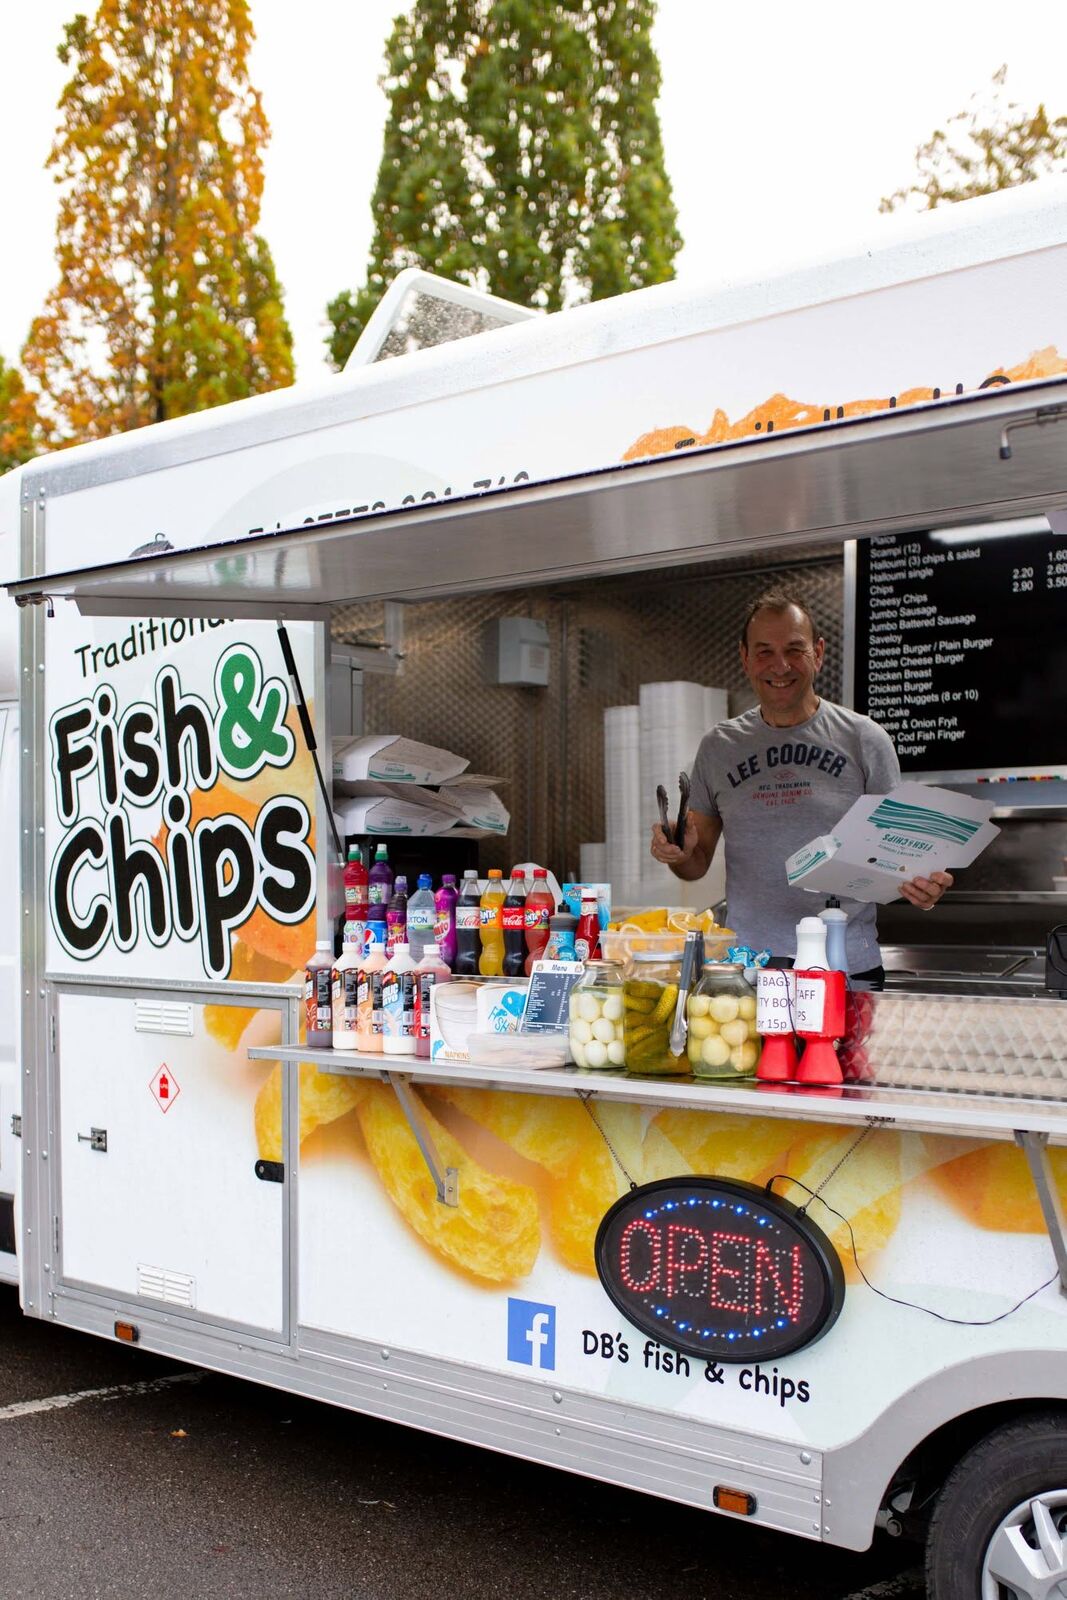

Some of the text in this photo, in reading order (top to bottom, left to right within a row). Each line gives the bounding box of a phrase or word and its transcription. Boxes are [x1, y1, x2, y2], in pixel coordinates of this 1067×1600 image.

[903, 543, 921, 556] (12)
[870, 547, 980, 571] Halloumi (3) chips & salad
[870, 567, 934, 583] Halloumi single
[869, 585, 894, 595] Chips
[869, 593, 928, 608] Cheesy Chips
[869, 606, 937, 621] Jumbo Sausage
[869, 614, 976, 633] Jumbo Battered Sausage
[869, 634, 902, 645] Saveloy
[74, 618, 234, 677] Tradition
[868, 647, 901, 657] Cheese
[903, 643, 932, 655] Burger
[938, 640, 961, 651] Plain
[963, 638, 993, 650] Burger
[868, 653, 965, 670] Double Cheese Burger
[868, 668, 932, 682] Chicken Breast
[868, 681, 933, 695] Chicken Burger
[868, 695, 902, 707] Chicken
[904, 693, 939, 706] Nuggets
[952, 692, 962, 700] or
[964, 689, 979, 701] 10)
[868, 707, 910, 719] Fish Cake
[902, 719, 908, 729] &
[910, 717, 936, 728] Onion
[53, 648, 292, 821] Fish &
[897, 731, 915, 742] Cod
[917, 730, 935, 741] Fish
[937, 730, 965, 741] Finger
[897, 744, 927, 756] Burger
[727, 743, 847, 788] LEE COOPER
[882, 833, 908, 845] CHIPS
[912, 840, 933, 851] FISH
[53, 791, 314, 976] Chips
[763, 976, 791, 987] BAGS
[772, 997, 795, 1008] BOX
[768, 1018, 787, 1030] 15p
[620, 1219, 804, 1323] OPEN
[582, 1330, 629, 1363] DB's
[643, 1342, 690, 1377] fish
[704, 1361, 724, 1384] &
[739, 1364, 811, 1407] chips
